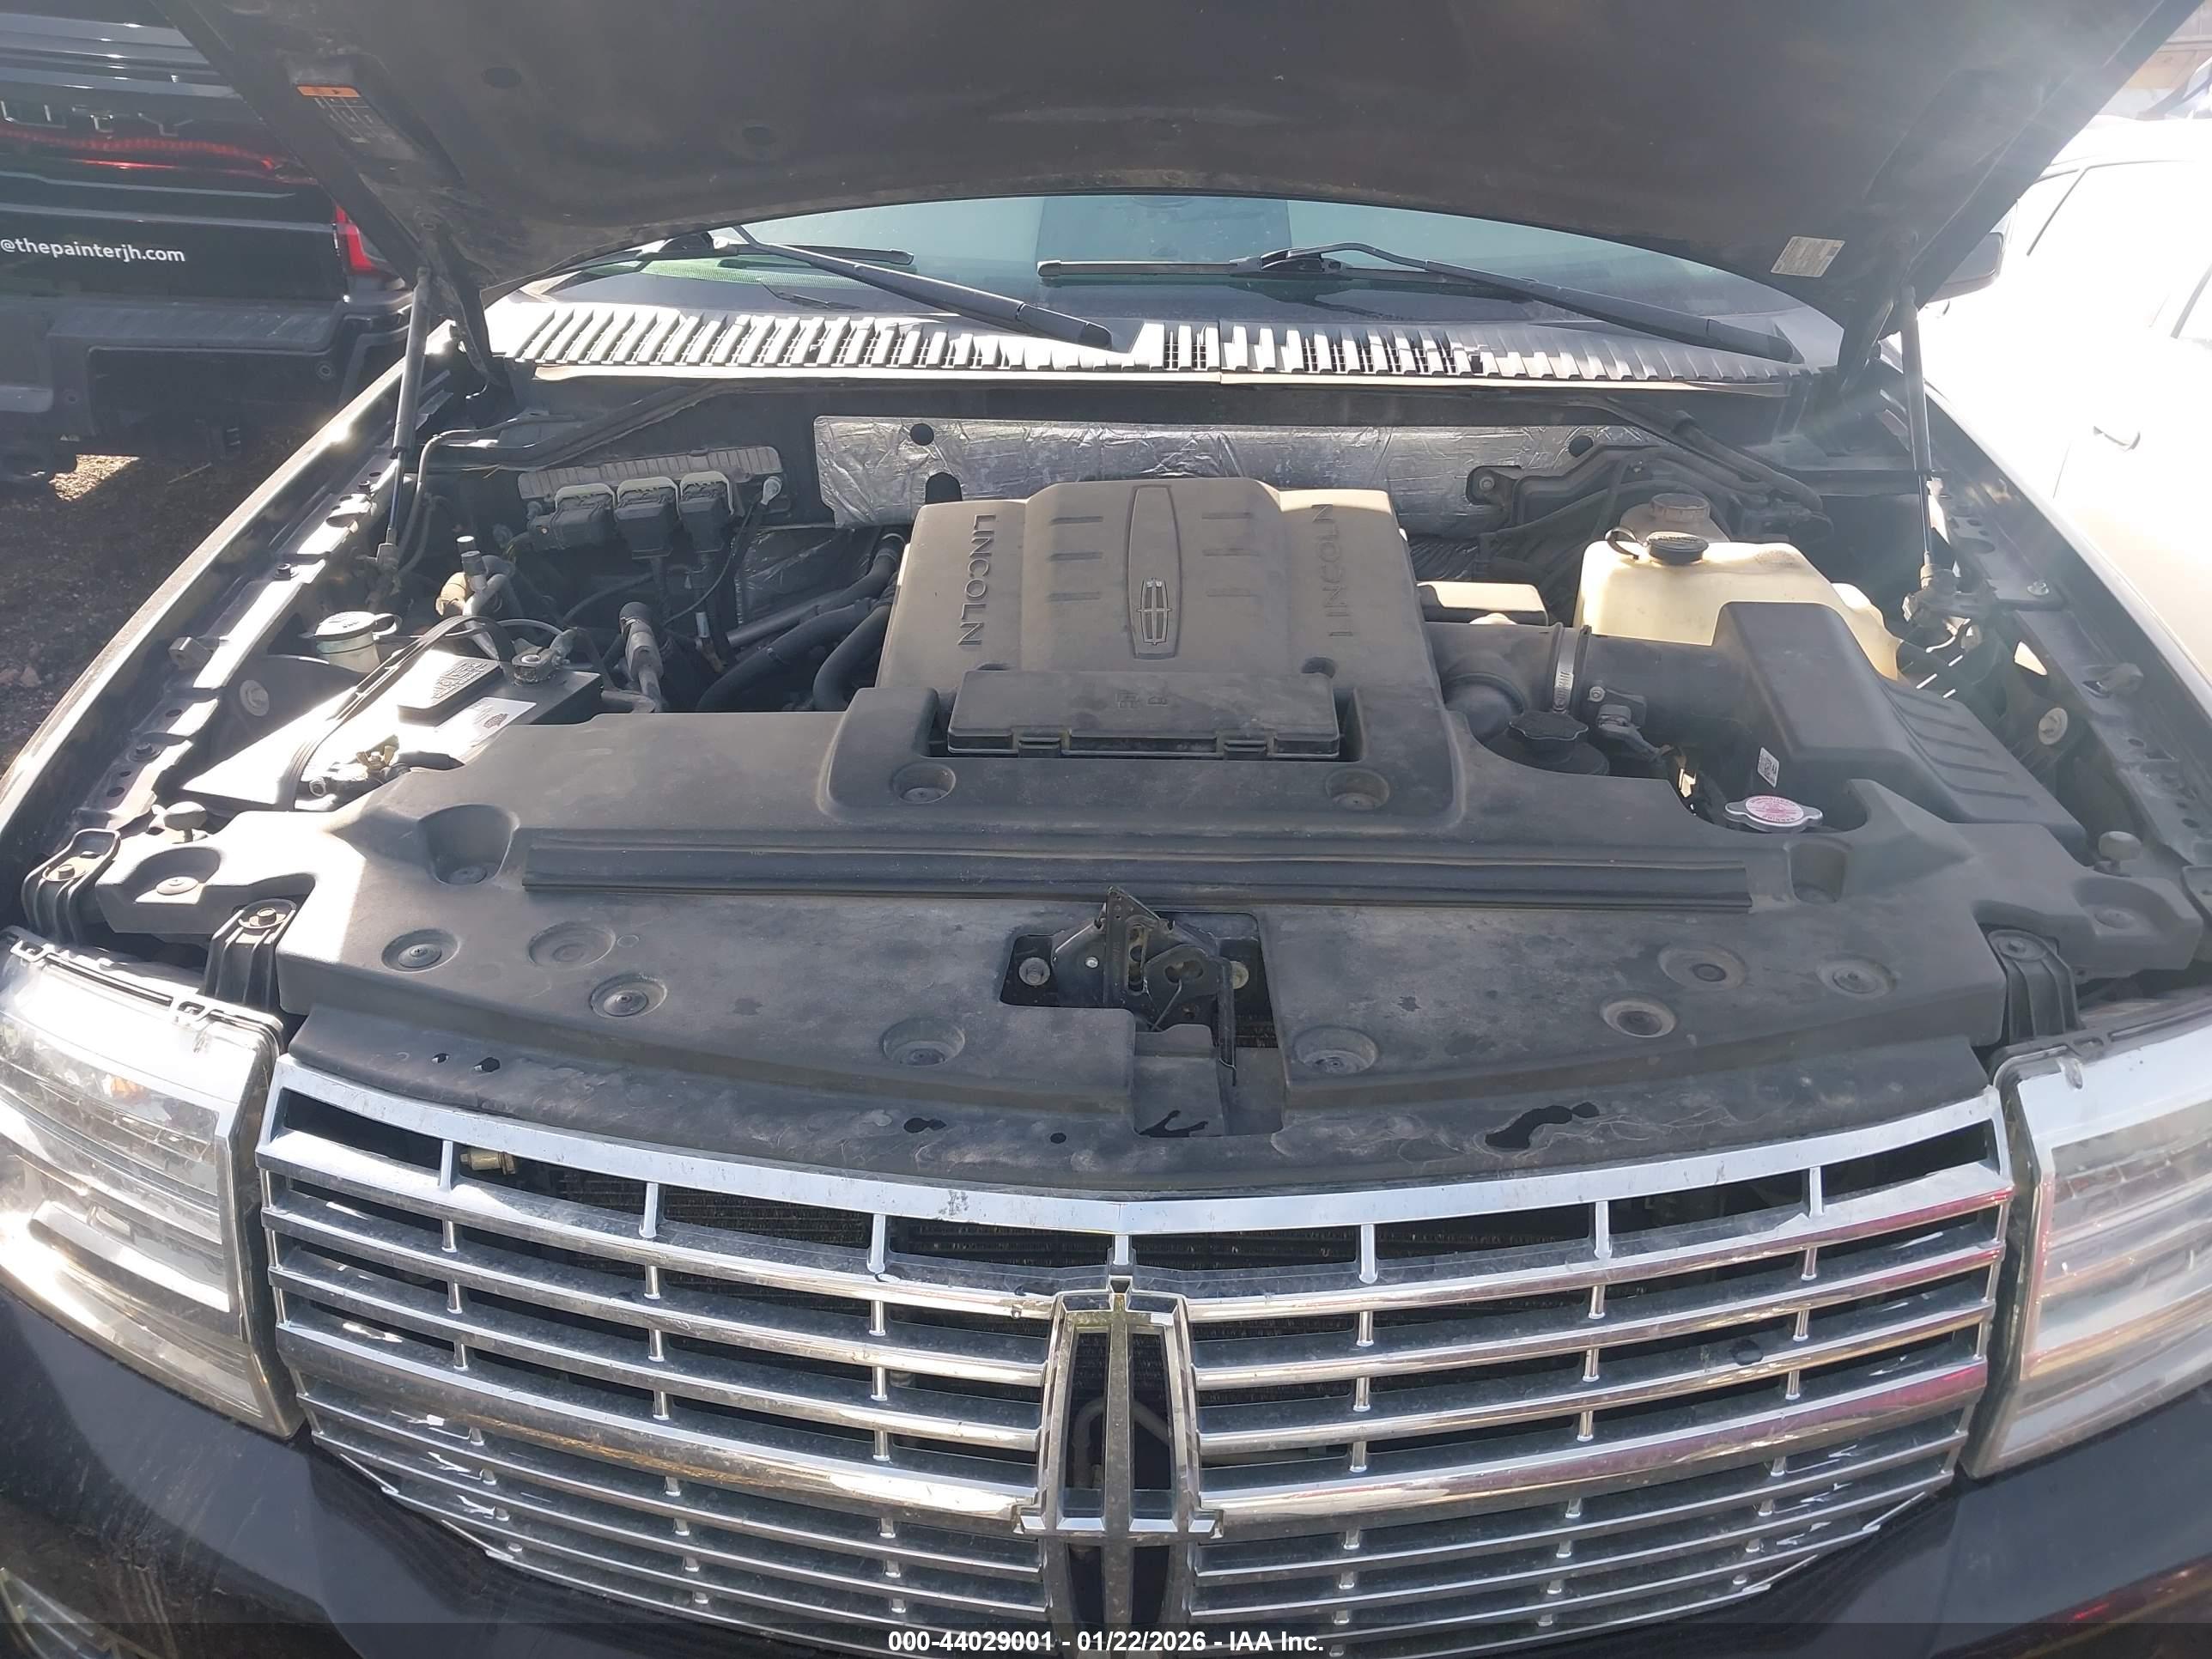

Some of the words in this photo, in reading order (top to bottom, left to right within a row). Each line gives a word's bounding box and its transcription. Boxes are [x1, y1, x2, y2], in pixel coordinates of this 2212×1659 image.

[0, 238, 185, 262] @thepainterjh.com
[957, 514, 996, 646] LINCOLN
[1311, 504, 1354, 637] LINCOLN
